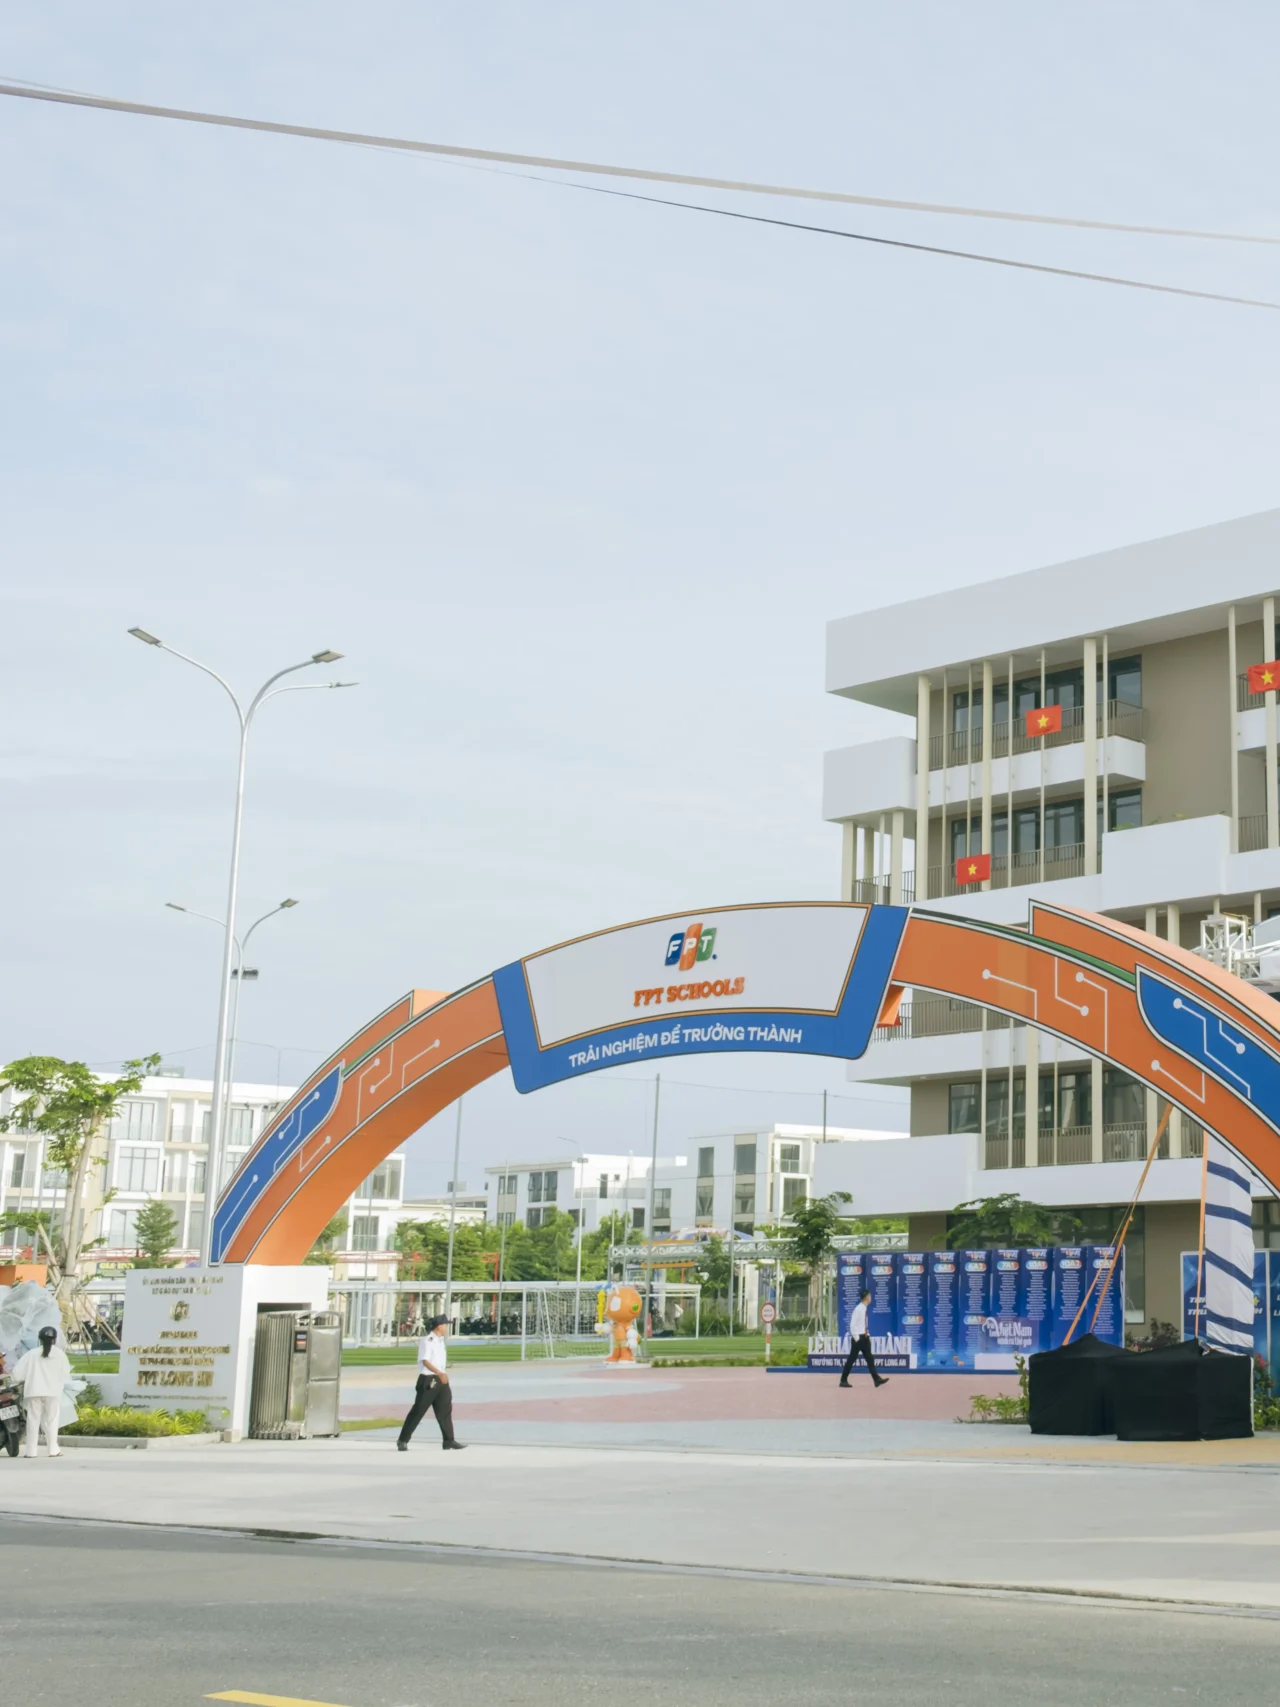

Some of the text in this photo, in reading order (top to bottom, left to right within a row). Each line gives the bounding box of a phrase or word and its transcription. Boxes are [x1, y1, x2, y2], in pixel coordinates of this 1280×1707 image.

[665, 929, 713, 963] FPT
[633, 977, 745, 1007] FPT SCHOOLS
[568, 1022, 802, 1067] TRẢI NGHIỆM ĐỂ TRƯỞNG THÀNH
[870, 1331, 912, 1354] THÀNH
[160, 1370, 194, 1387] LONG
